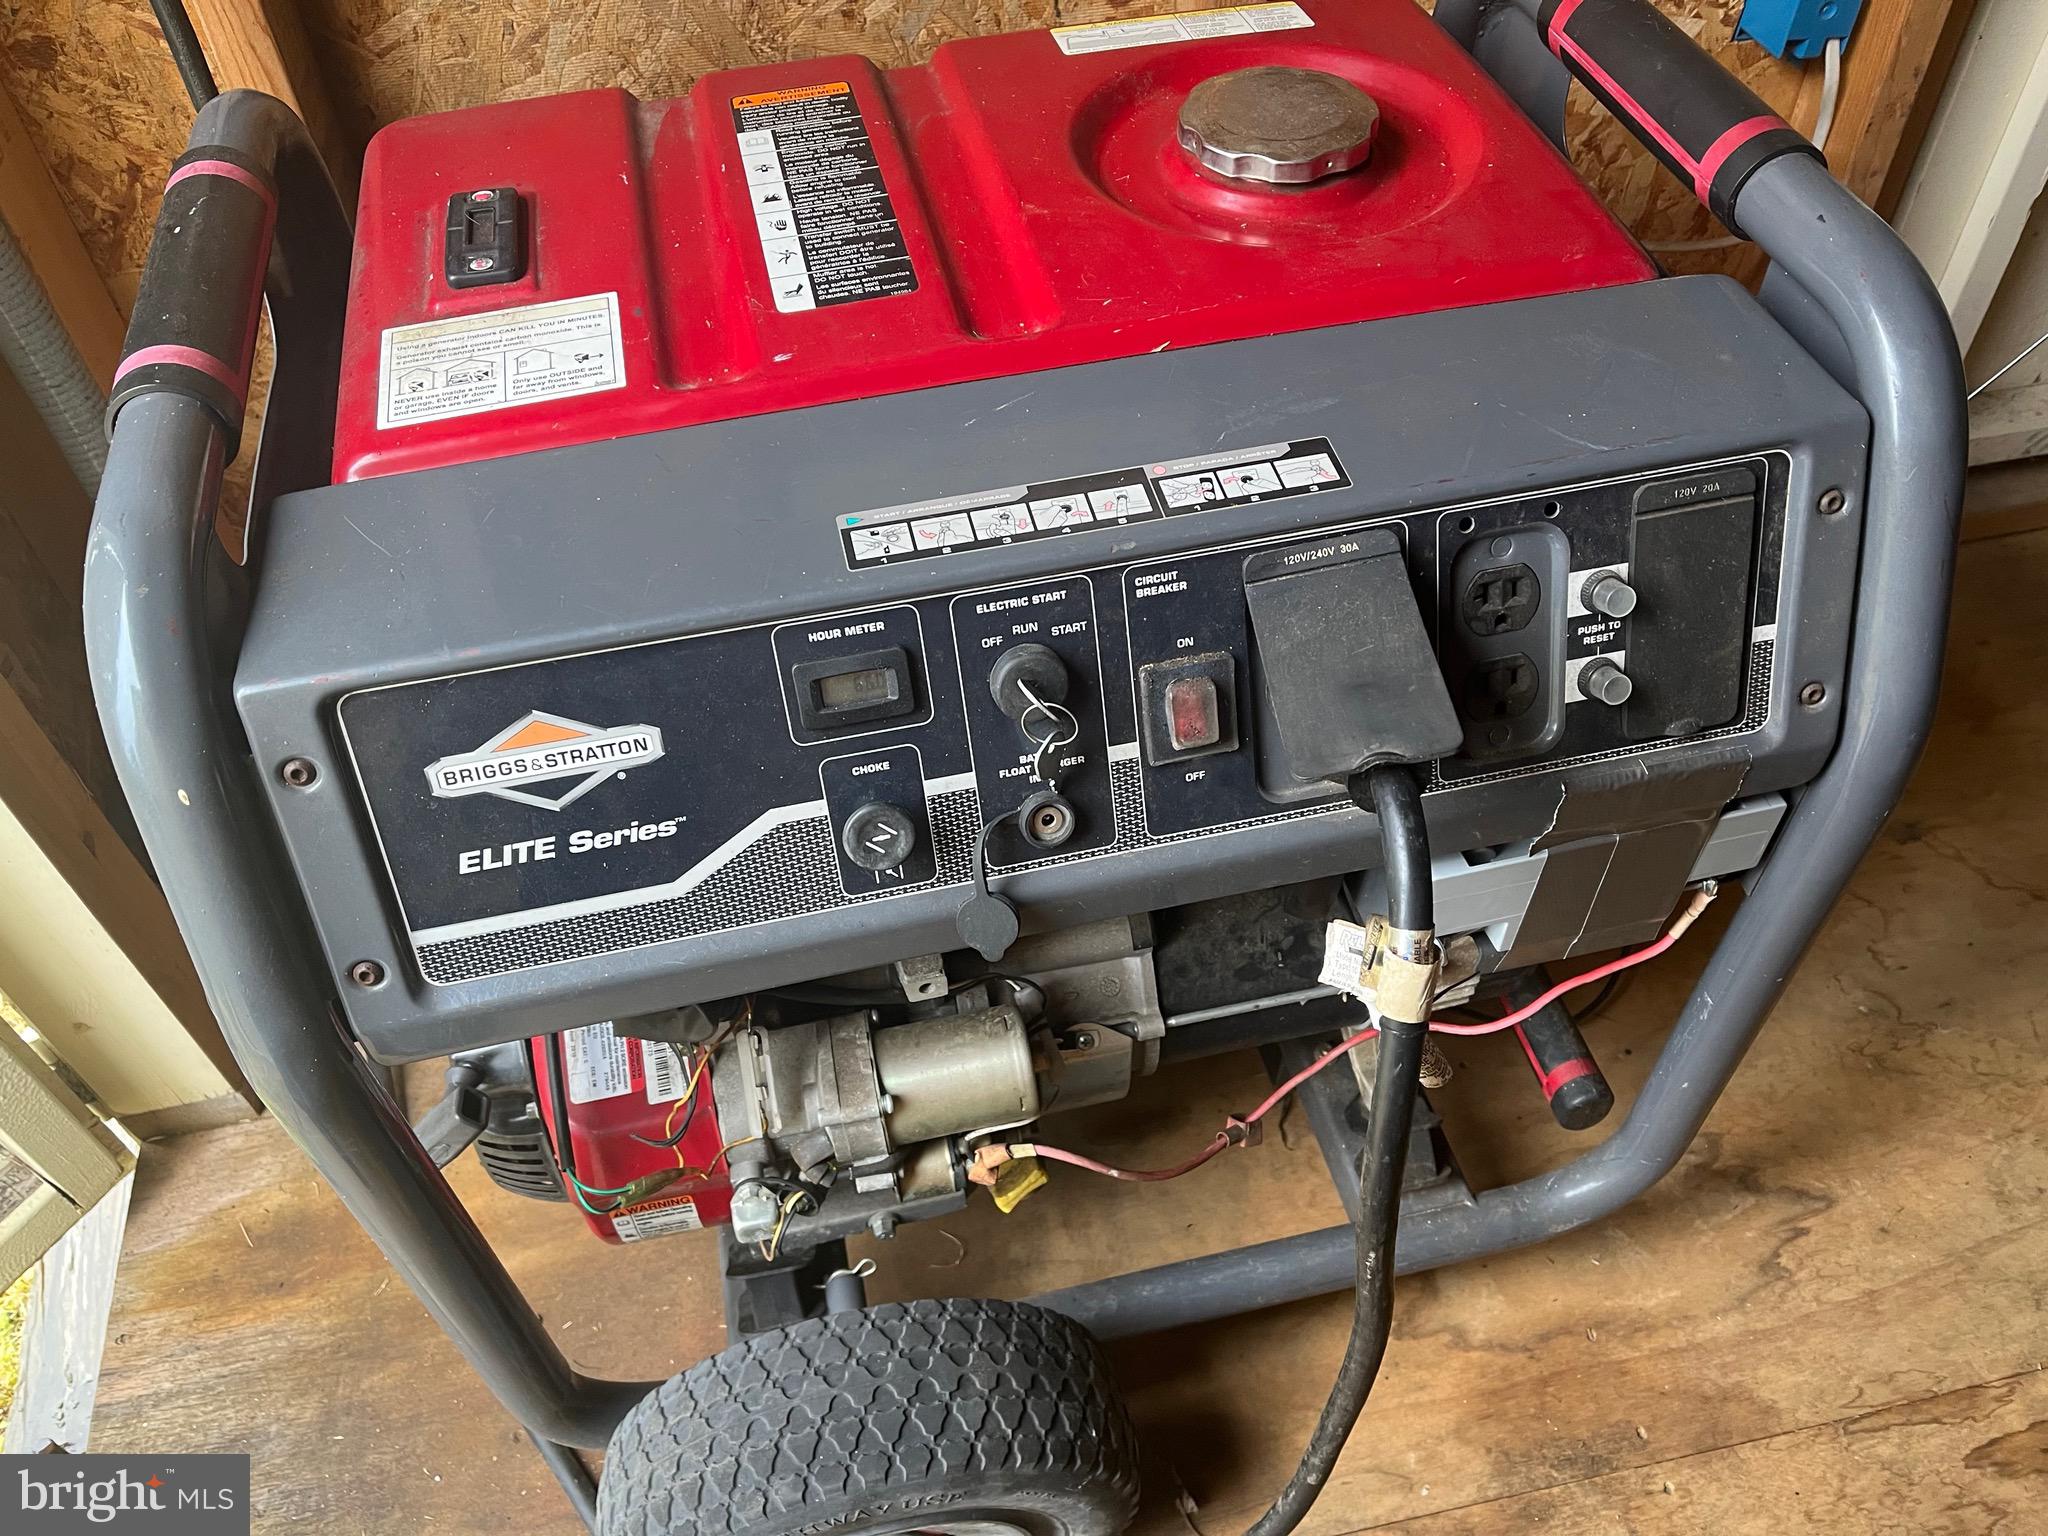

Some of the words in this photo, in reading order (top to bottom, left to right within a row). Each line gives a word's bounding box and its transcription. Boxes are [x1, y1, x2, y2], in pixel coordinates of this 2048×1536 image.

[428, 336, 465, 347] generator
[437, 344, 467, 353] exhaust
[448, 349, 475, 357] cannot
[513, 377, 530, 385] Only
[549, 367, 585, 378] OUTSIDE
[525, 380, 546, 388] away
[394, 395, 422, 405] NEVER
[442, 388, 466, 396] inside
[475, 383, 497, 391] home
[436, 395, 459, 403] EVEN
[471, 389, 494, 397] doors
[411, 403, 446, 414] windows
[1308, 484, 1320, 492] 3
[1674, 486, 1697, 499] 120V
[1703, 482, 1720, 493] 20A
[1060, 526, 1072, 534] 4
[1282, 546, 1335, 566] 120V/240V
[1340, 542, 1360, 554] 30A
[1135, 571, 1178, 587] CIRCUIT
[1136, 581, 1187, 598] BREAKER
[976, 597, 1029, 614] ELECTRIC
[1032, 590, 1067, 605] START
[808, 629, 842, 643] HOUR
[844, 621, 885, 638] METER
[981, 636, 1003, 649] OFF
[1012, 622, 1038, 635] RUN
[1051, 621, 1087, 636] START
[1577, 624, 1605, 637] PUSH
[1607, 621, 1621, 633] TO
[1177, 637, 1193, 649] ON
[1583, 631, 1615, 645] RESET
[851, 761, 890, 777] CHOKE
[999, 765, 1032, 780] FLOAT
[1186, 771, 1206, 782] OFF
[459, 835, 556, 876] ELITE
[626, 1197, 691, 1215] WARNING
